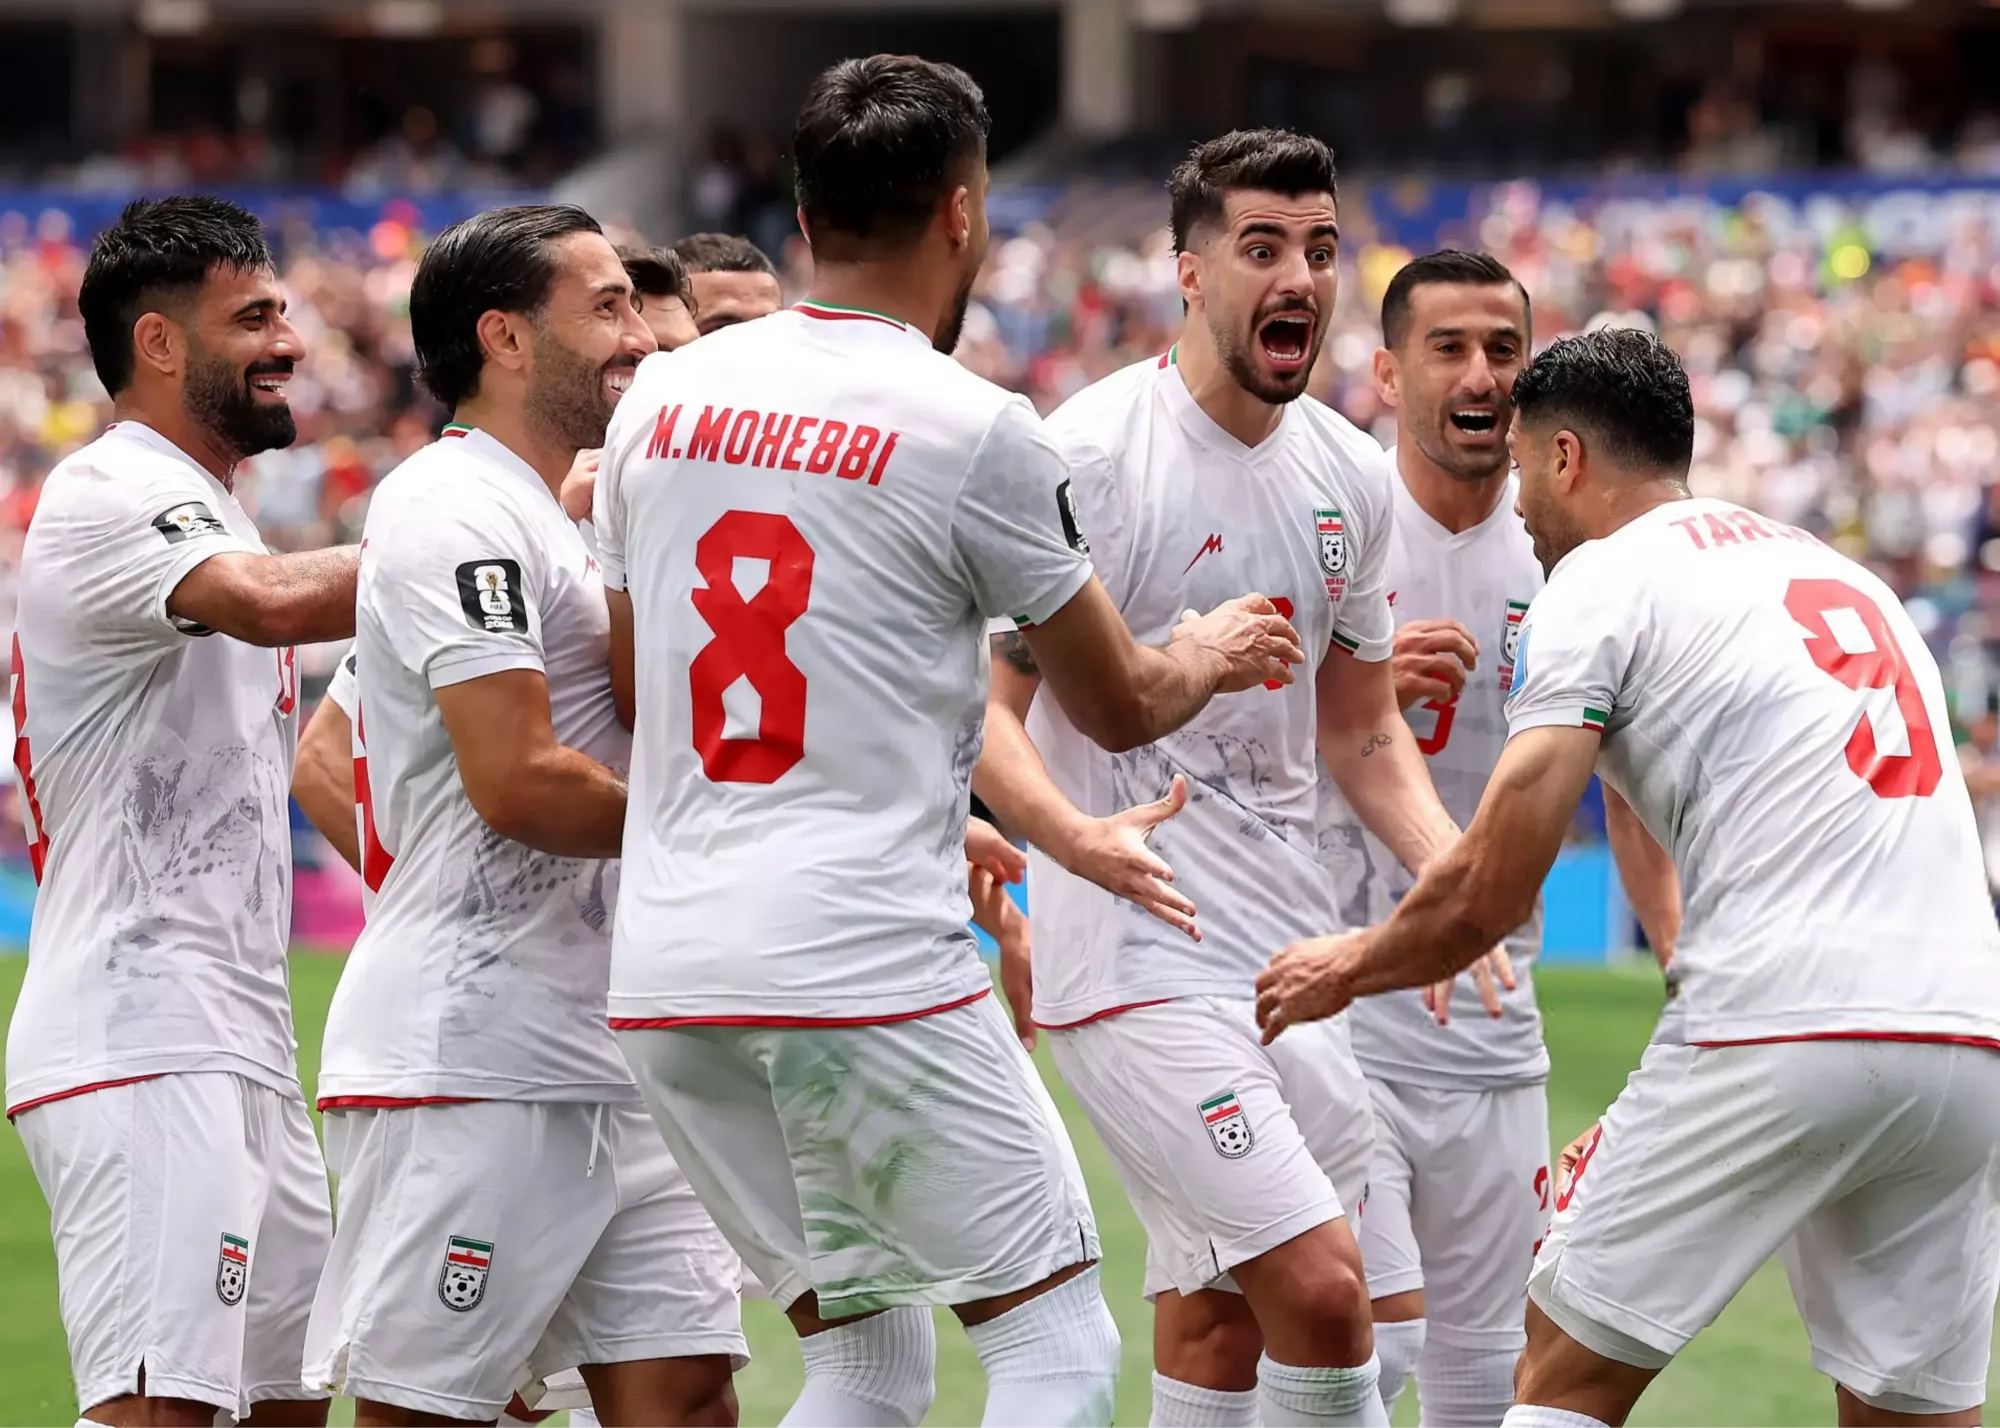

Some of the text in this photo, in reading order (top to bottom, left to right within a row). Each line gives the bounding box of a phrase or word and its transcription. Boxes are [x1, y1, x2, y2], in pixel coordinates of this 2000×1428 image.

[645, 404, 900, 486] M.MOHEBBI
[1668, 510, 1824, 550] TAR
[689, 509, 816, 784] 8
[1783, 578, 1943, 798] 9
